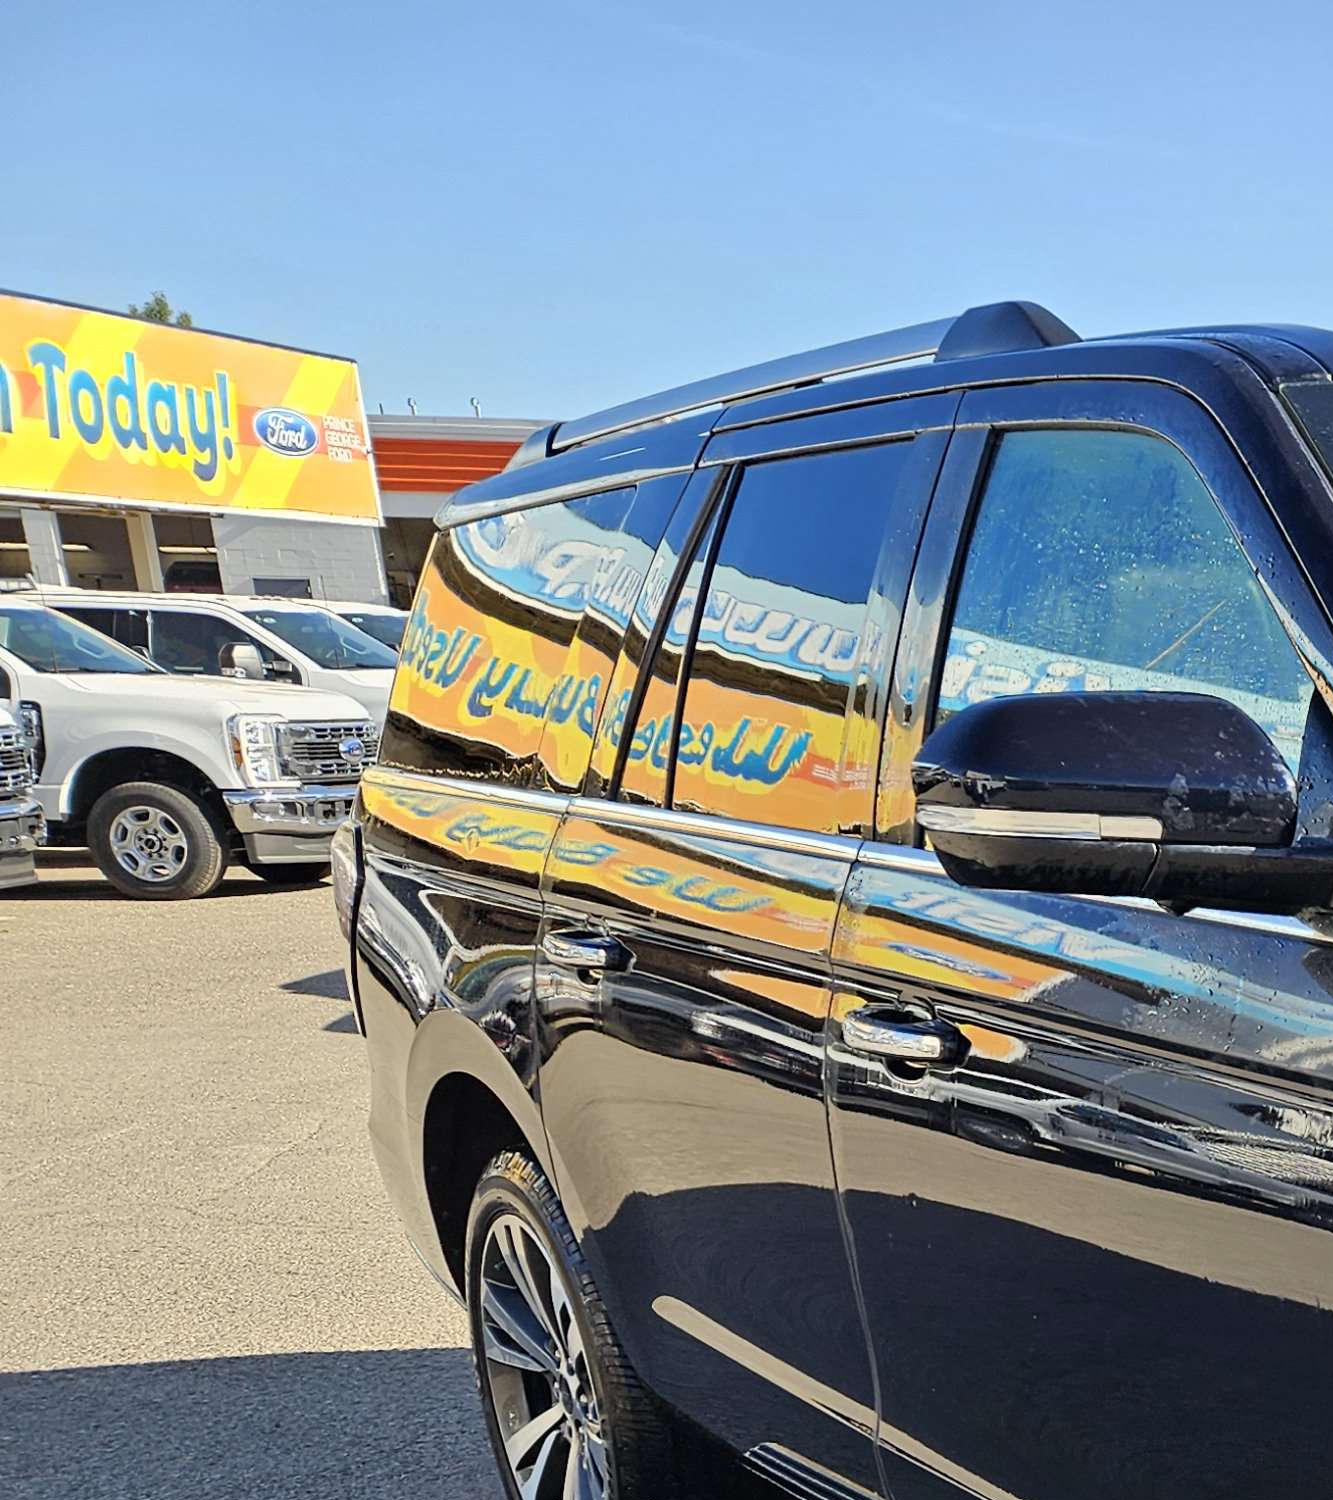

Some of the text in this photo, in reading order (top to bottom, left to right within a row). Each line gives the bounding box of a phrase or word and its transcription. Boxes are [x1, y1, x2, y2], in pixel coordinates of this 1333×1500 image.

[27, 341, 234, 482] Today!
[267, 412, 308, 450] Ford
[323, 415, 355, 433] PRINCE
[325, 431, 362, 449] GEORGE
[328, 448, 353, 463] FORD
